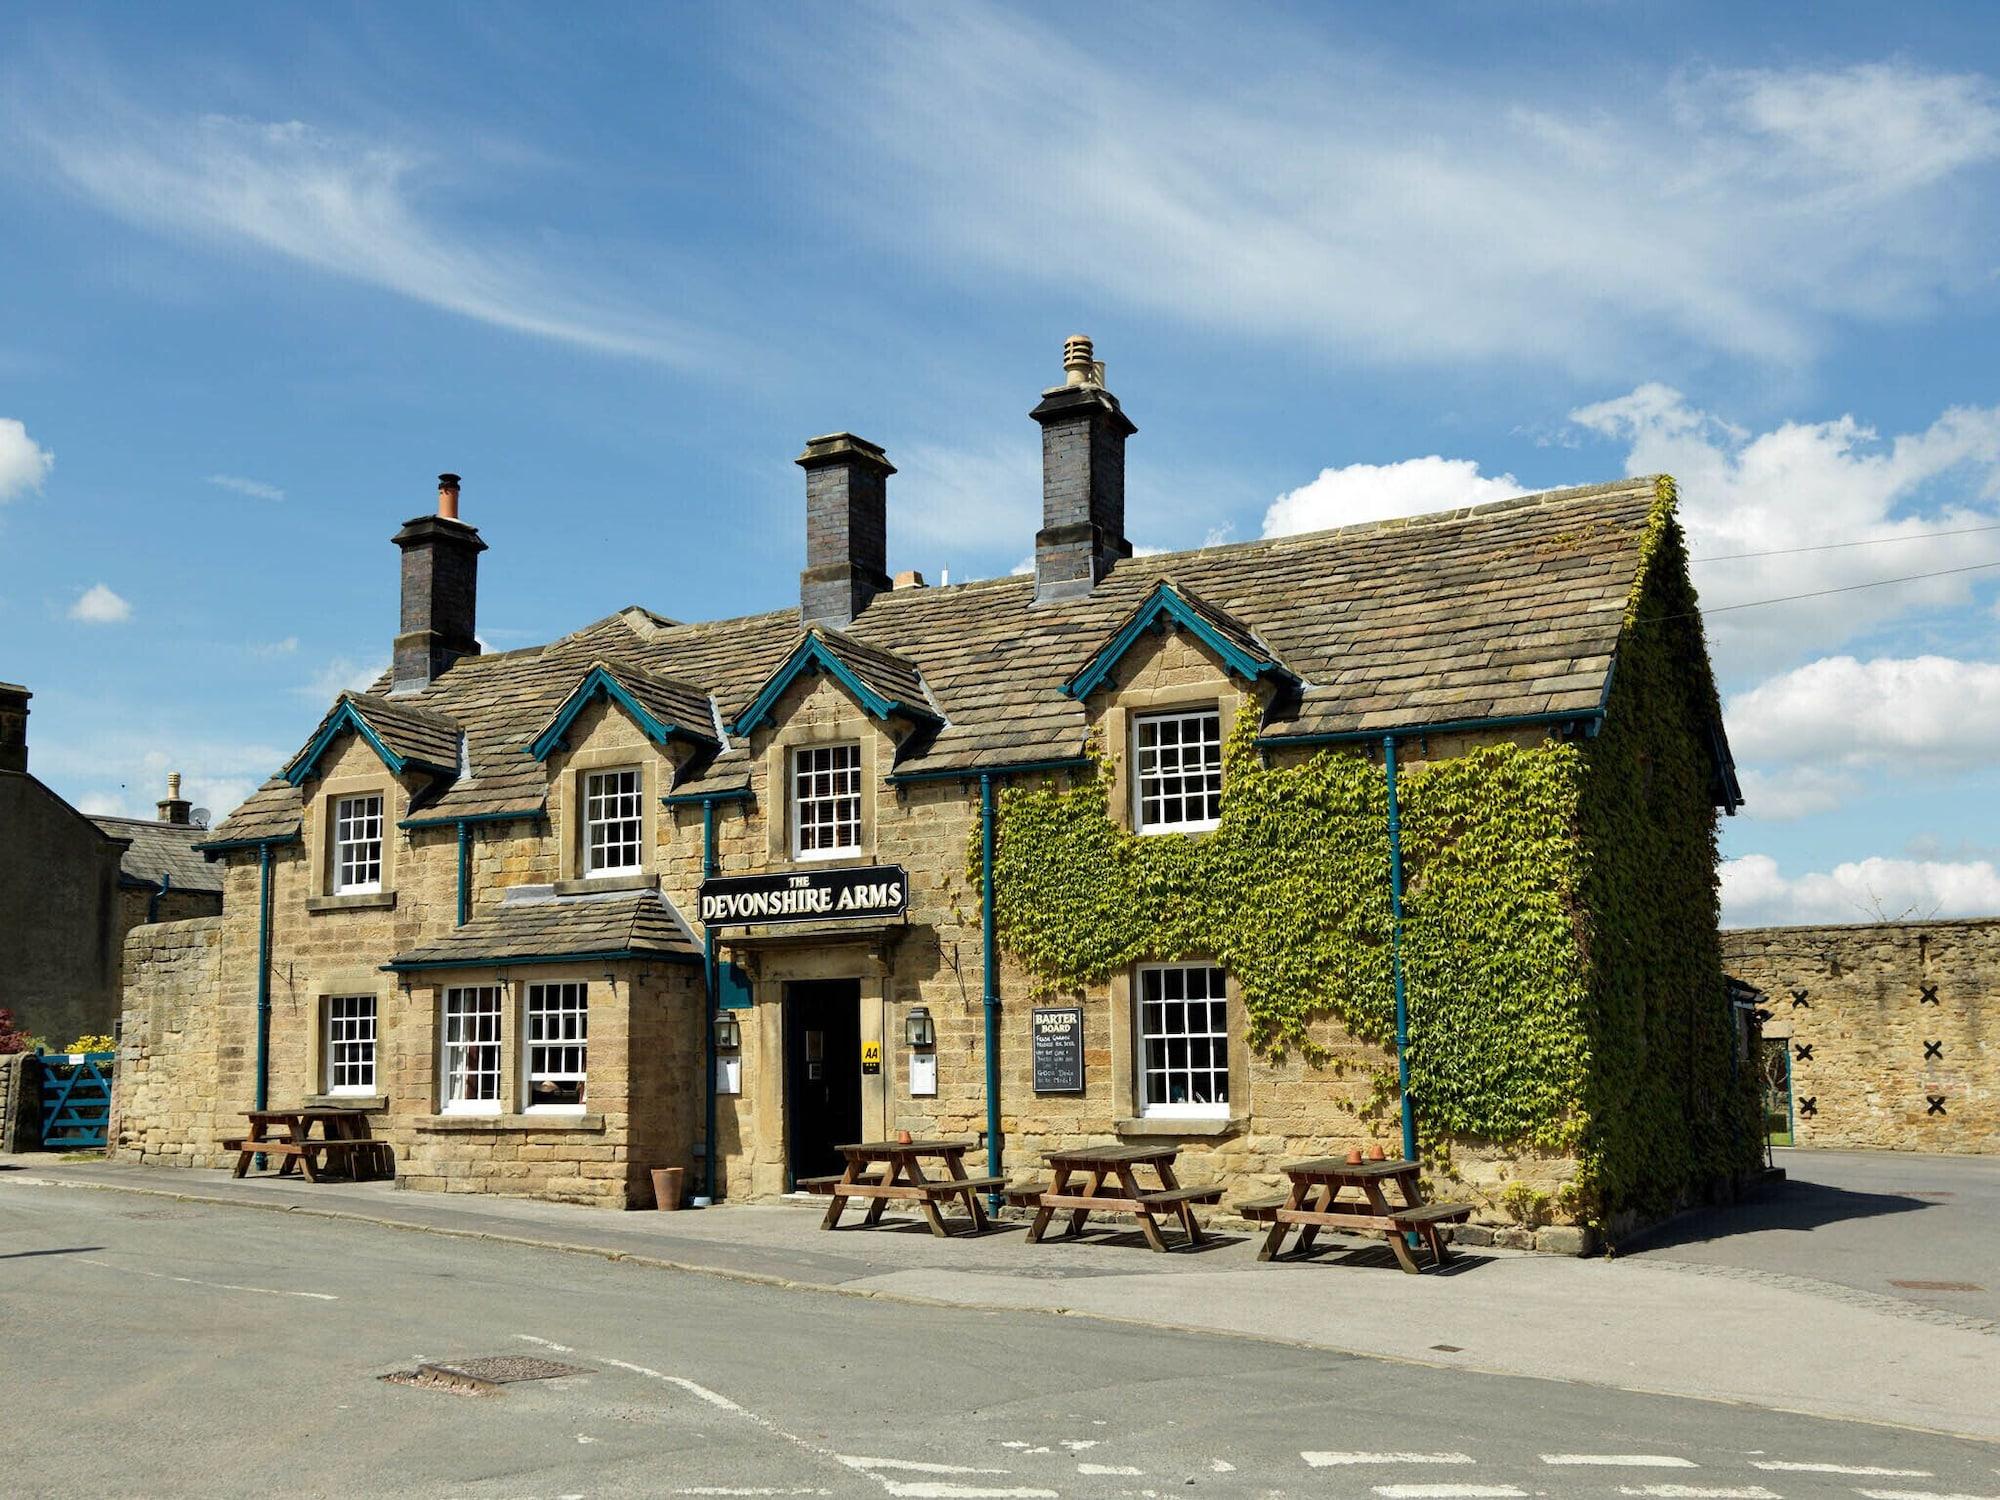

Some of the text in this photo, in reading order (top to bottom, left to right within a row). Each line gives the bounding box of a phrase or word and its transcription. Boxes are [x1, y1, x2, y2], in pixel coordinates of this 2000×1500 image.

[788, 876, 810, 889] THE
[702, 883, 902, 919] DEVONSHIRE ARMS
[1035, 1013, 1077, 1025] BARTER
[1041, 1024, 1071, 1034] BOARD
[865, 1048, 878, 1059] AA
